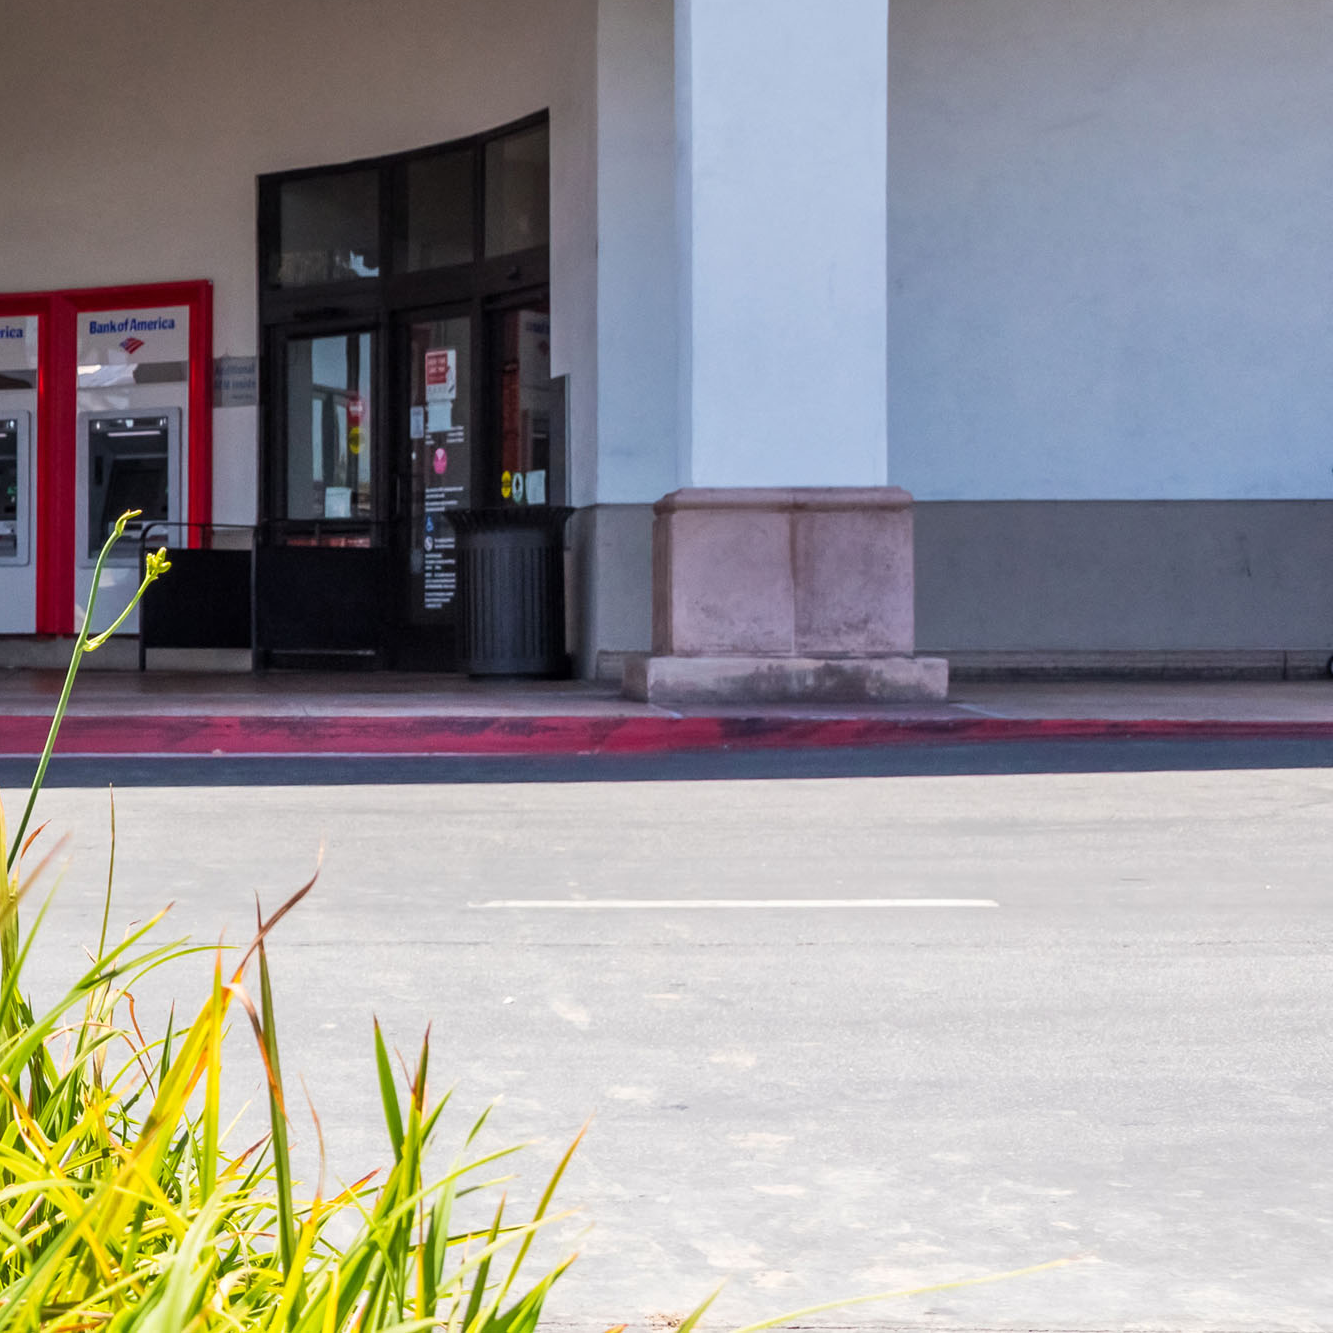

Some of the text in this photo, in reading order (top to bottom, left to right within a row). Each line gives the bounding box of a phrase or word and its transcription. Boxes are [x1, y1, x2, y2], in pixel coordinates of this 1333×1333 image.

[90, 316, 175, 335] Bank of America
